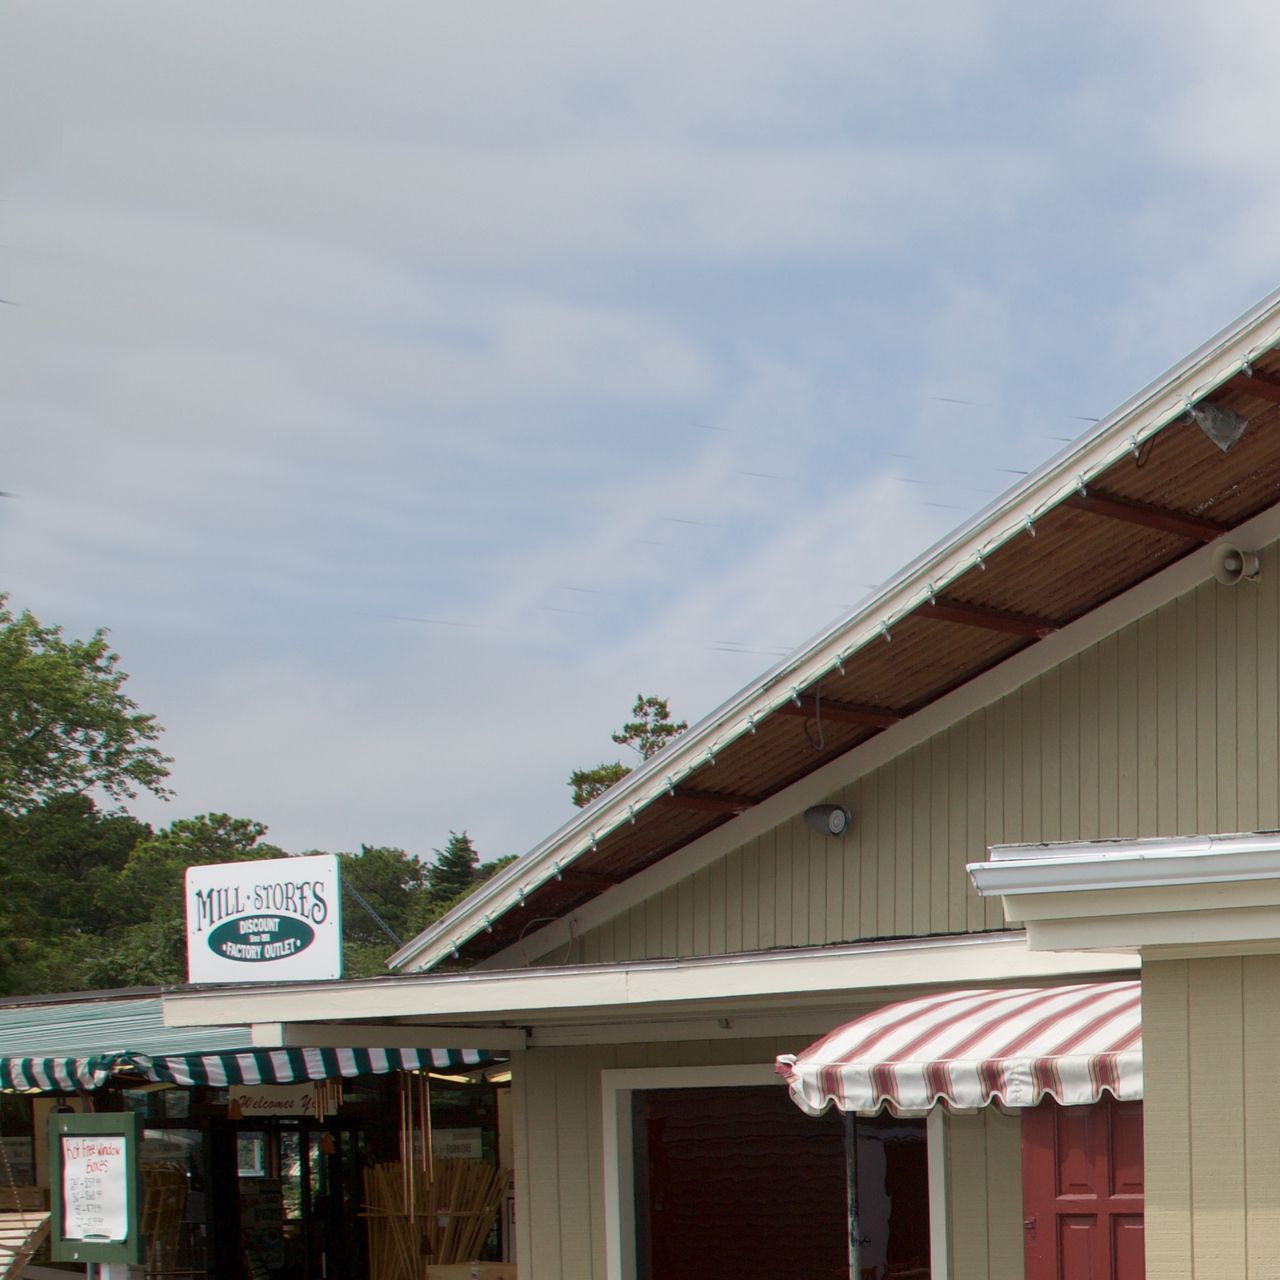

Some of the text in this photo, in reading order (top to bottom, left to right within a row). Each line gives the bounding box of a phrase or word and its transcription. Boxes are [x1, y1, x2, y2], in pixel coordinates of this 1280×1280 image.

[195, 881, 328, 931] MILL STORES
[239, 918, 281, 934] DISCOUNT
[225, 938, 296, 959] FACTORY OUTLET
[240, 1095, 294, 1110] Welcomes
